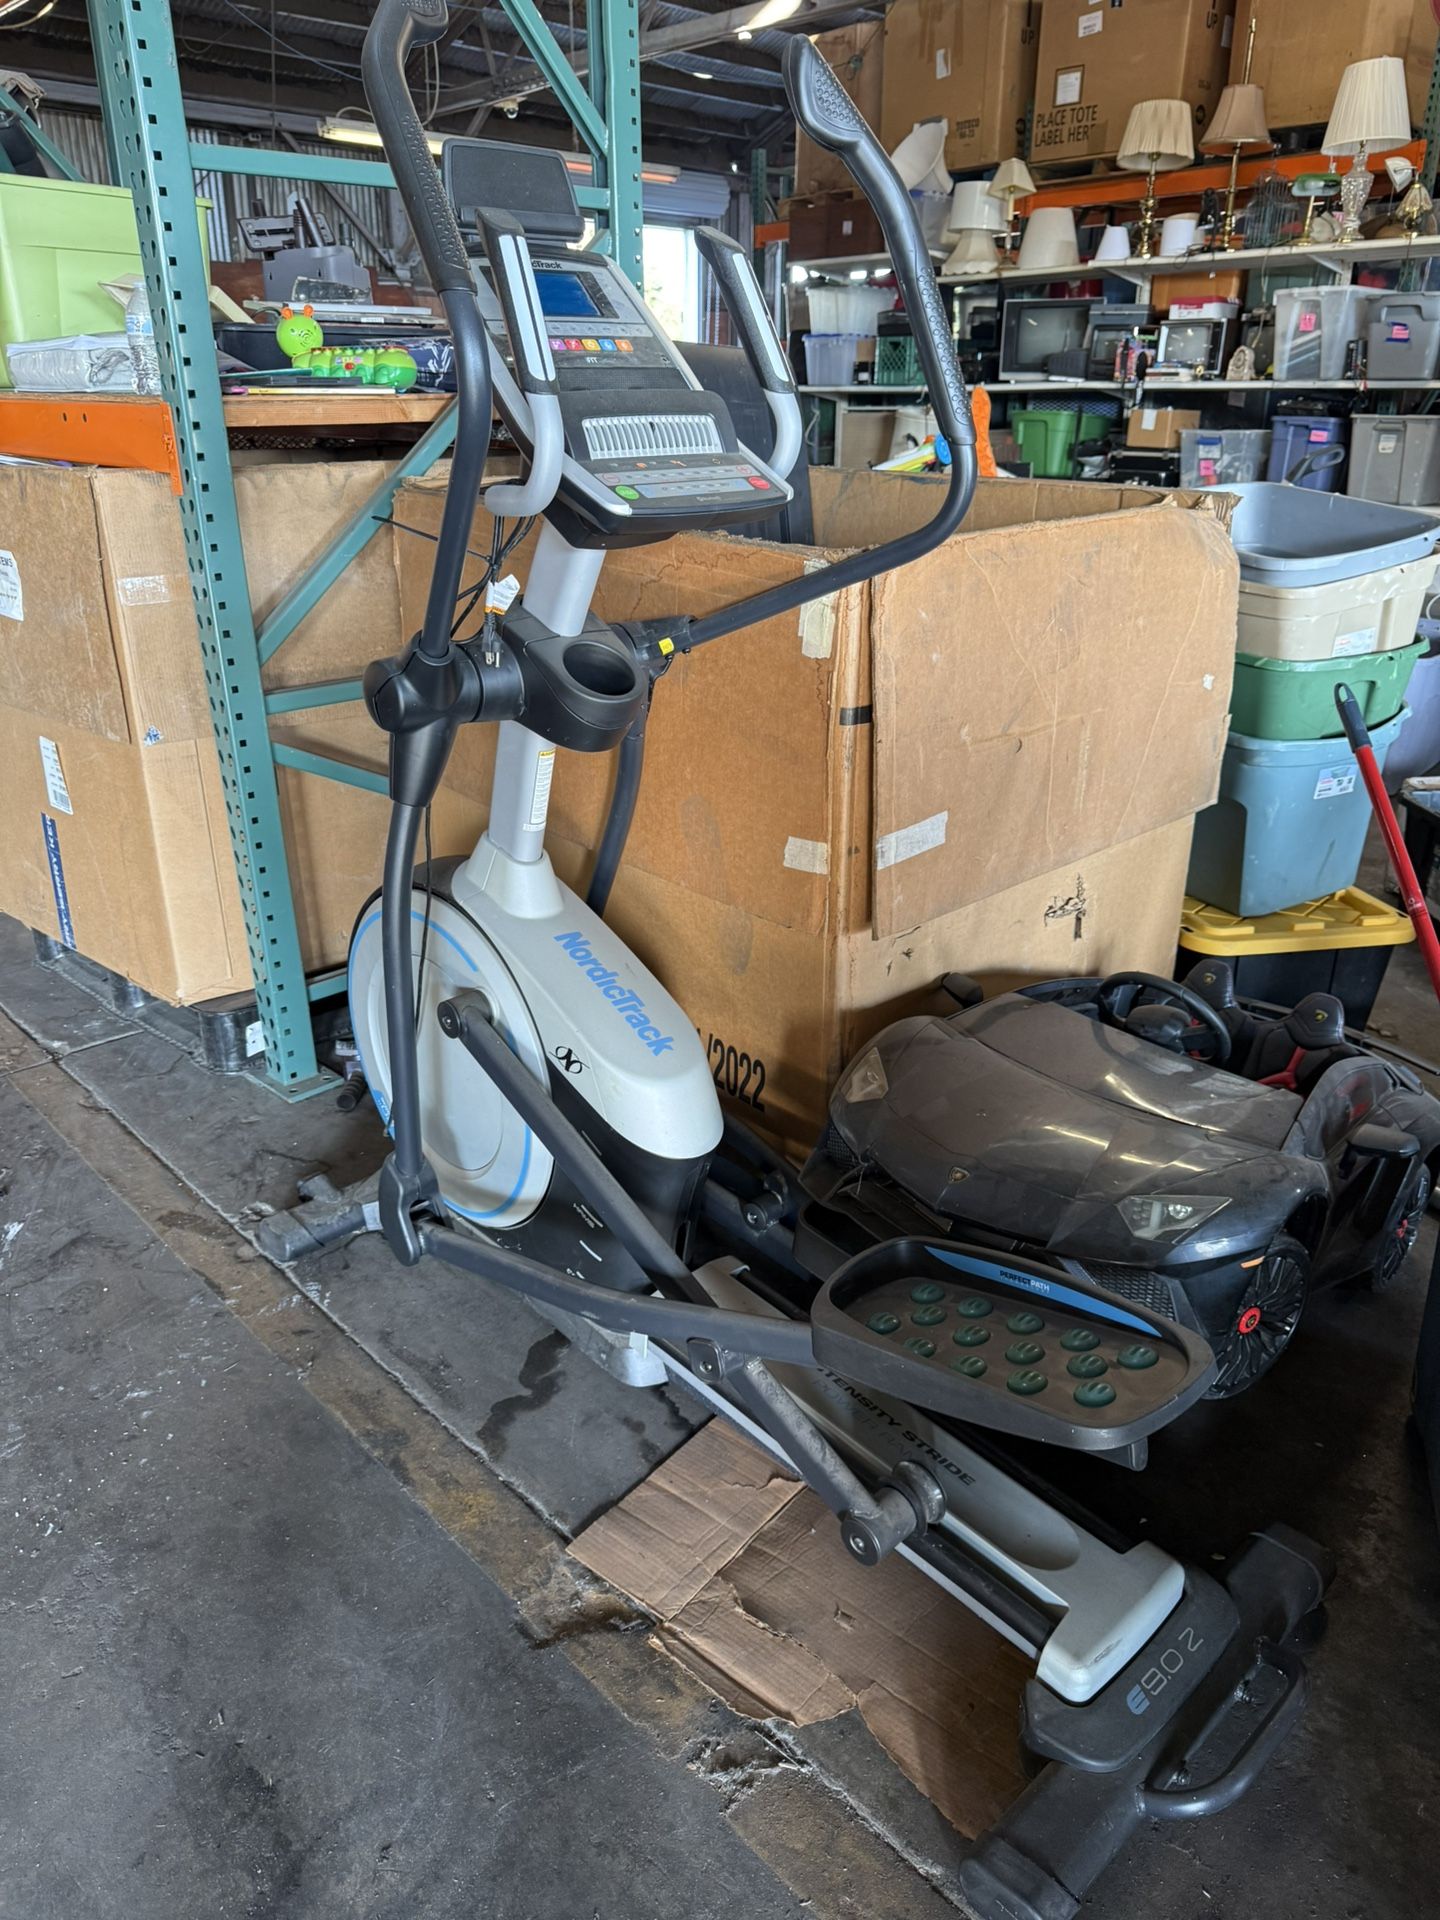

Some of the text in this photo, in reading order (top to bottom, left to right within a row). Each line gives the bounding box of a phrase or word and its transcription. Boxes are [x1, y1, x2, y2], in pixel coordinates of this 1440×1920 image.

[1207, 11, 1219, 29] UP
[1021, 29, 1035, 45] UP
[1036, 104, 1099, 129] PLACE TOTE
[1034, 128, 1064, 148] LABEL
[530, 260, 562, 269] cTrack
[553, 931, 674, 1057] NordicTrack
[817, 1367, 977, 1487] TENSITY STRIDE
